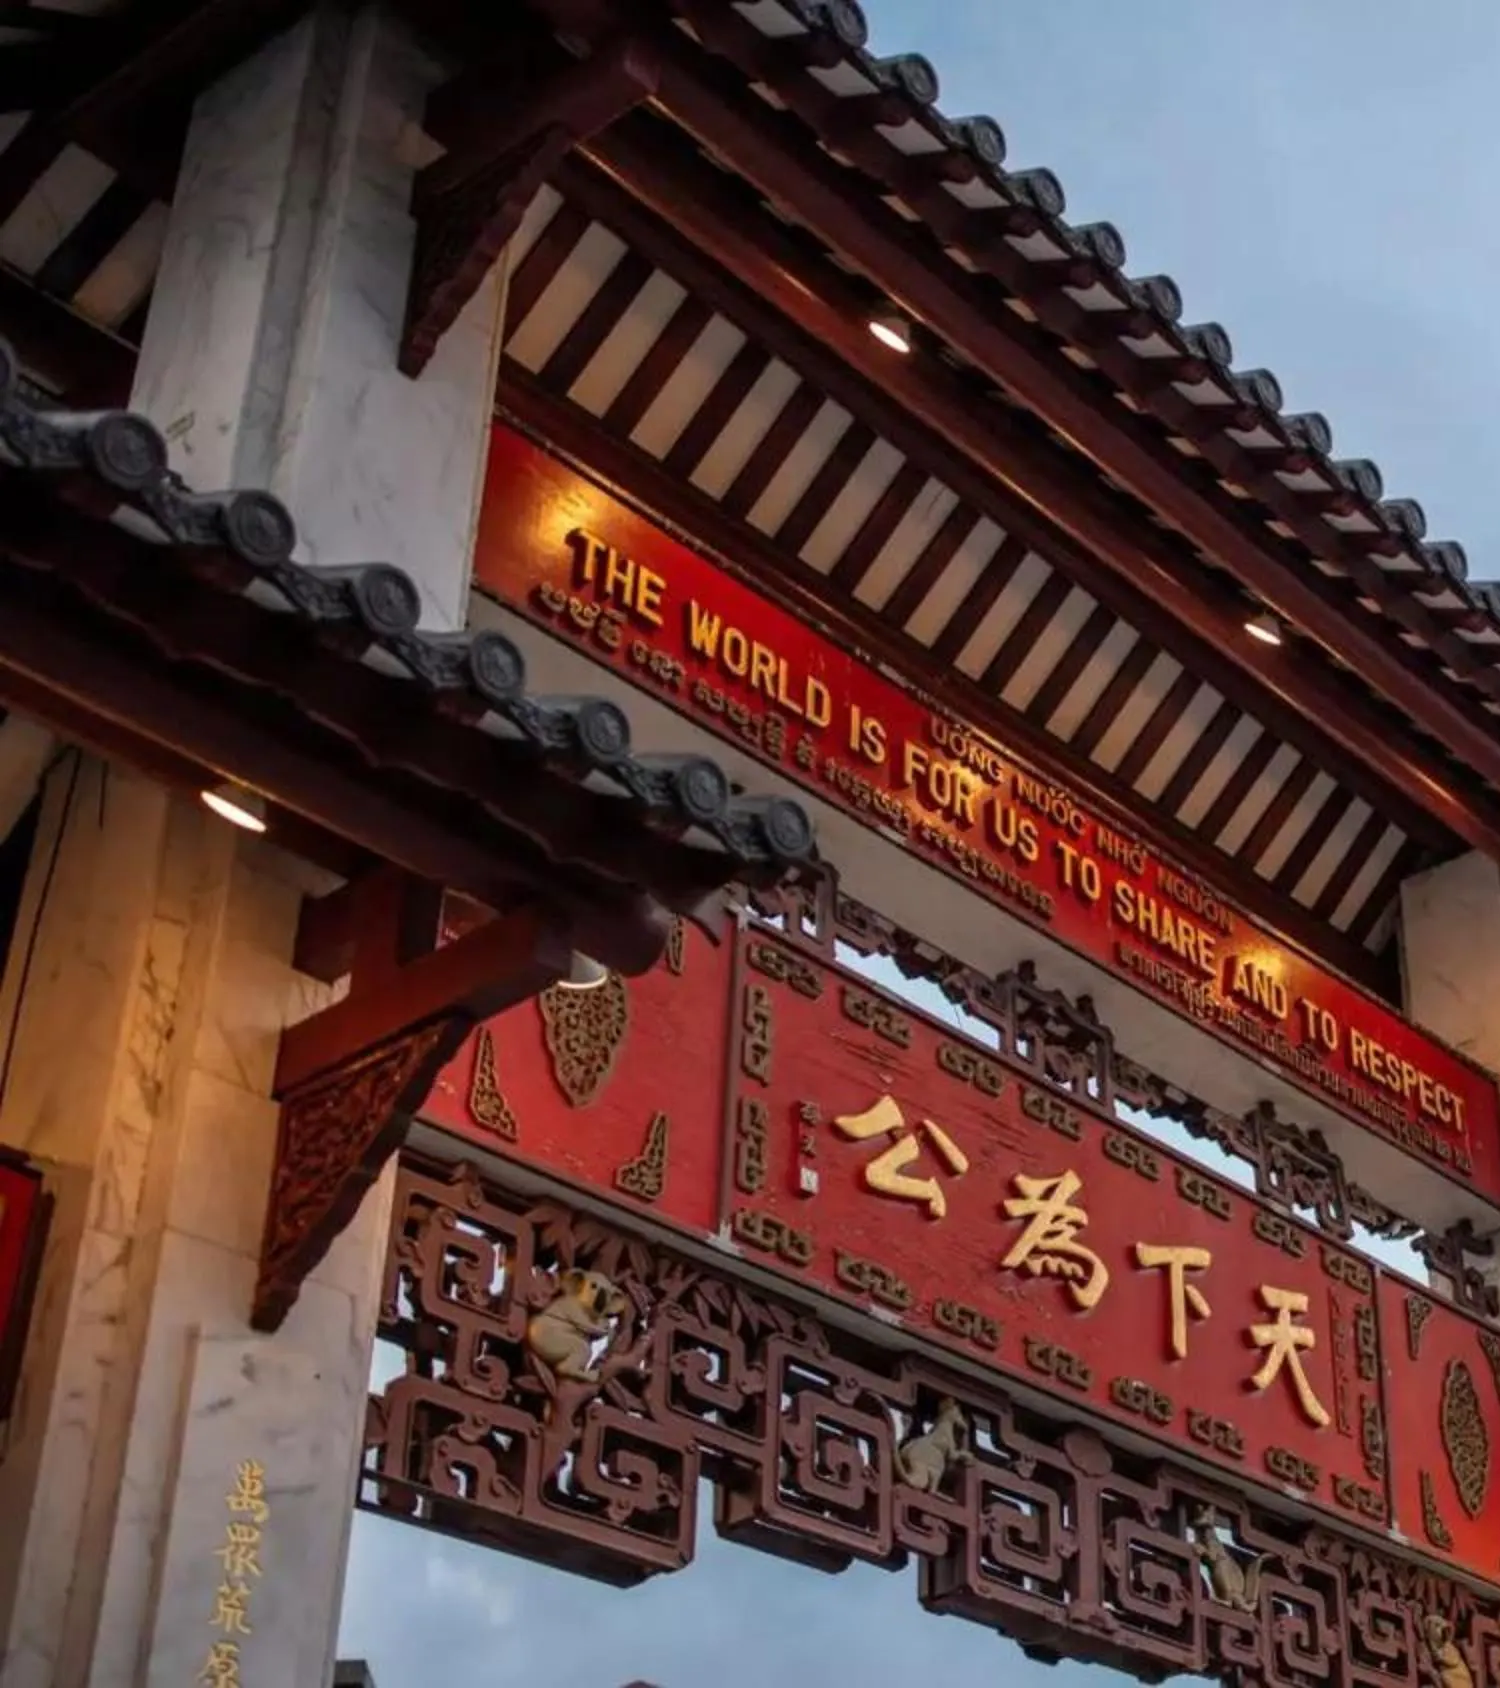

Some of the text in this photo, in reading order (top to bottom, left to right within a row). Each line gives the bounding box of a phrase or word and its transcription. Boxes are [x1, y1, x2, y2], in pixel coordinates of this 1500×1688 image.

[575, 526, 668, 627] THE
[689, 598, 832, 729] WORLD
[848, 702, 888, 765] IS
[903, 738, 985, 825] FOR
[993, 797, 1040, 863] US
[1056, 839, 1101, 901] TO
[1114, 878, 1218, 977] SHARE
[1232, 957, 1290, 1020] AND
[1301, 996, 1338, 1051] TO
[1349, 1025, 1467, 1132] RESPECT
